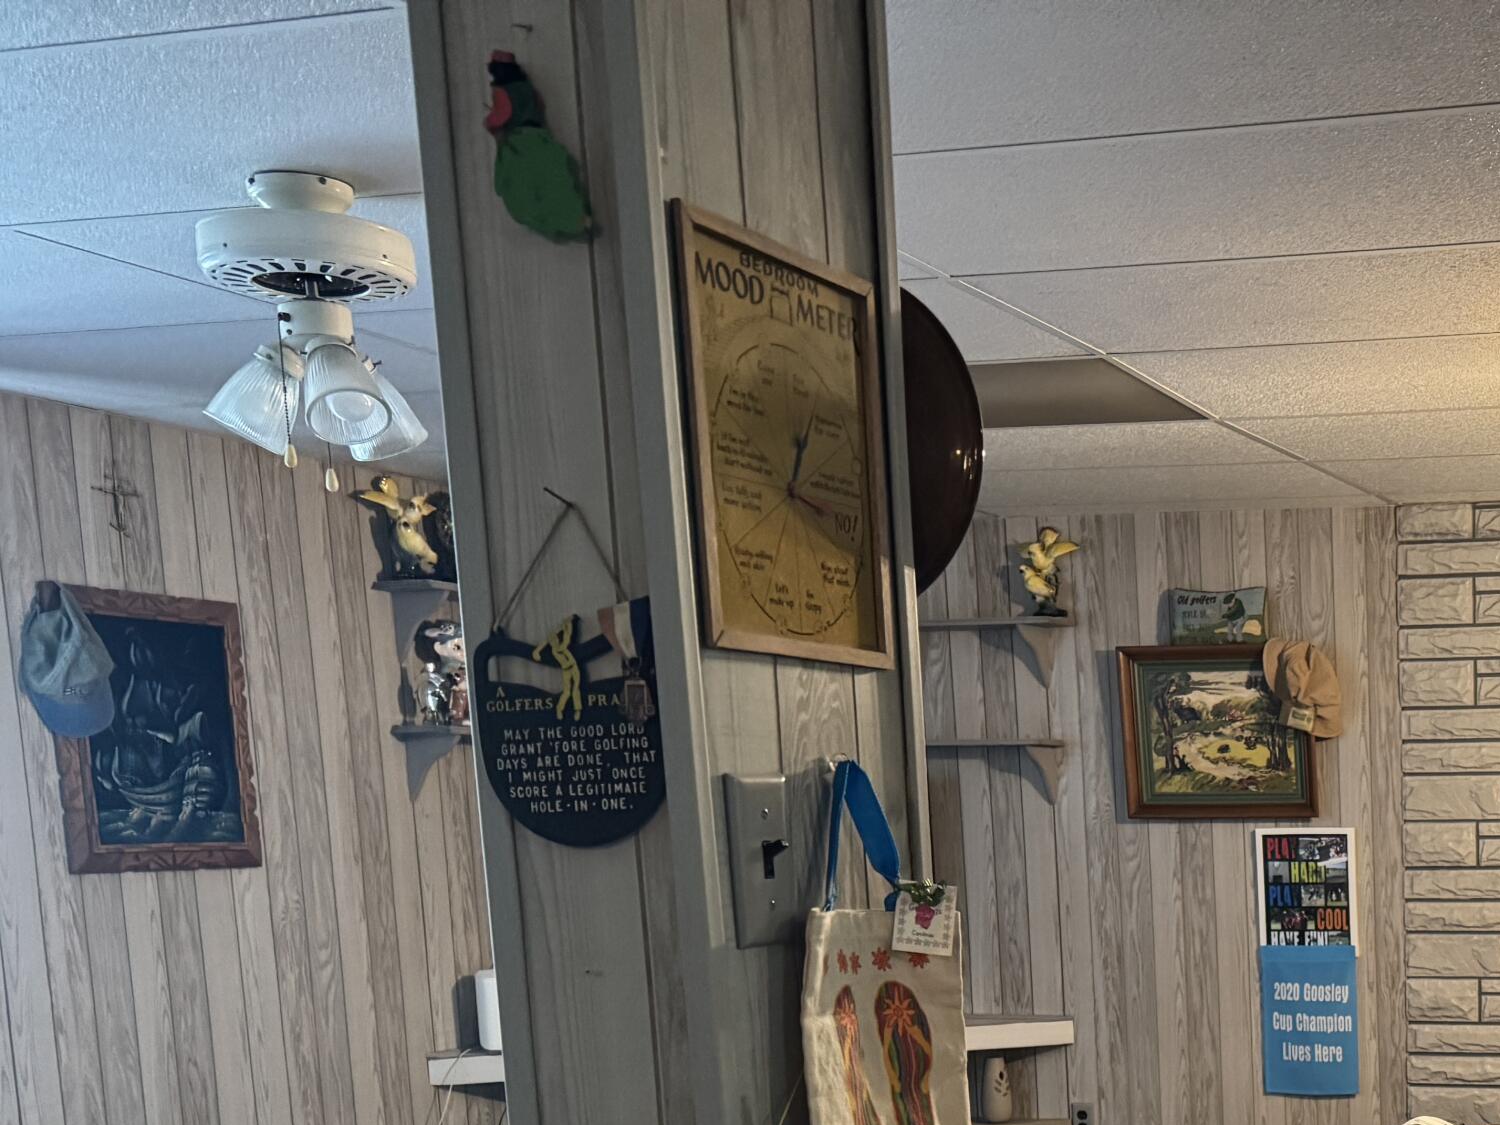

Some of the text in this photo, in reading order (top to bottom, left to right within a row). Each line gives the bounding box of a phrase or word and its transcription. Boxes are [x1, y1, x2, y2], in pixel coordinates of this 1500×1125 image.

[740, 252, 819, 298] BEDROOM
[694, 251, 857, 344] MOOD METER
[834, 512, 858, 542] NO!
[496, 686, 505, 698] A
[486, 693, 620, 712] GOLFERS PRA
[504, 723, 646, 741] MAY THE GOOD LORD
[501, 743, 542, 756] GRANT
[594, 738, 649, 751] GOLFING
[497, 757, 528, 770] DAYS
[537, 755, 561, 768] ARE
[623, 750, 656, 764] THAT
[522, 769, 564, 783] MIGHT
[572, 769, 602, 782] JUST
[611, 767, 646, 780] ONCE
[509, 782, 647, 798] SCORE A LEGITIMATE
[1269, 885, 1299, 906] PLA
[1317, 908, 1348, 930] COOL
[1270, 931, 1299, 946] HAVE
[1274, 982, 1349, 1003] 2020 Goosley
[1273, 1012, 1352, 1033] Cup Champion
[1282, 1042, 1343, 1063] Lives Here
